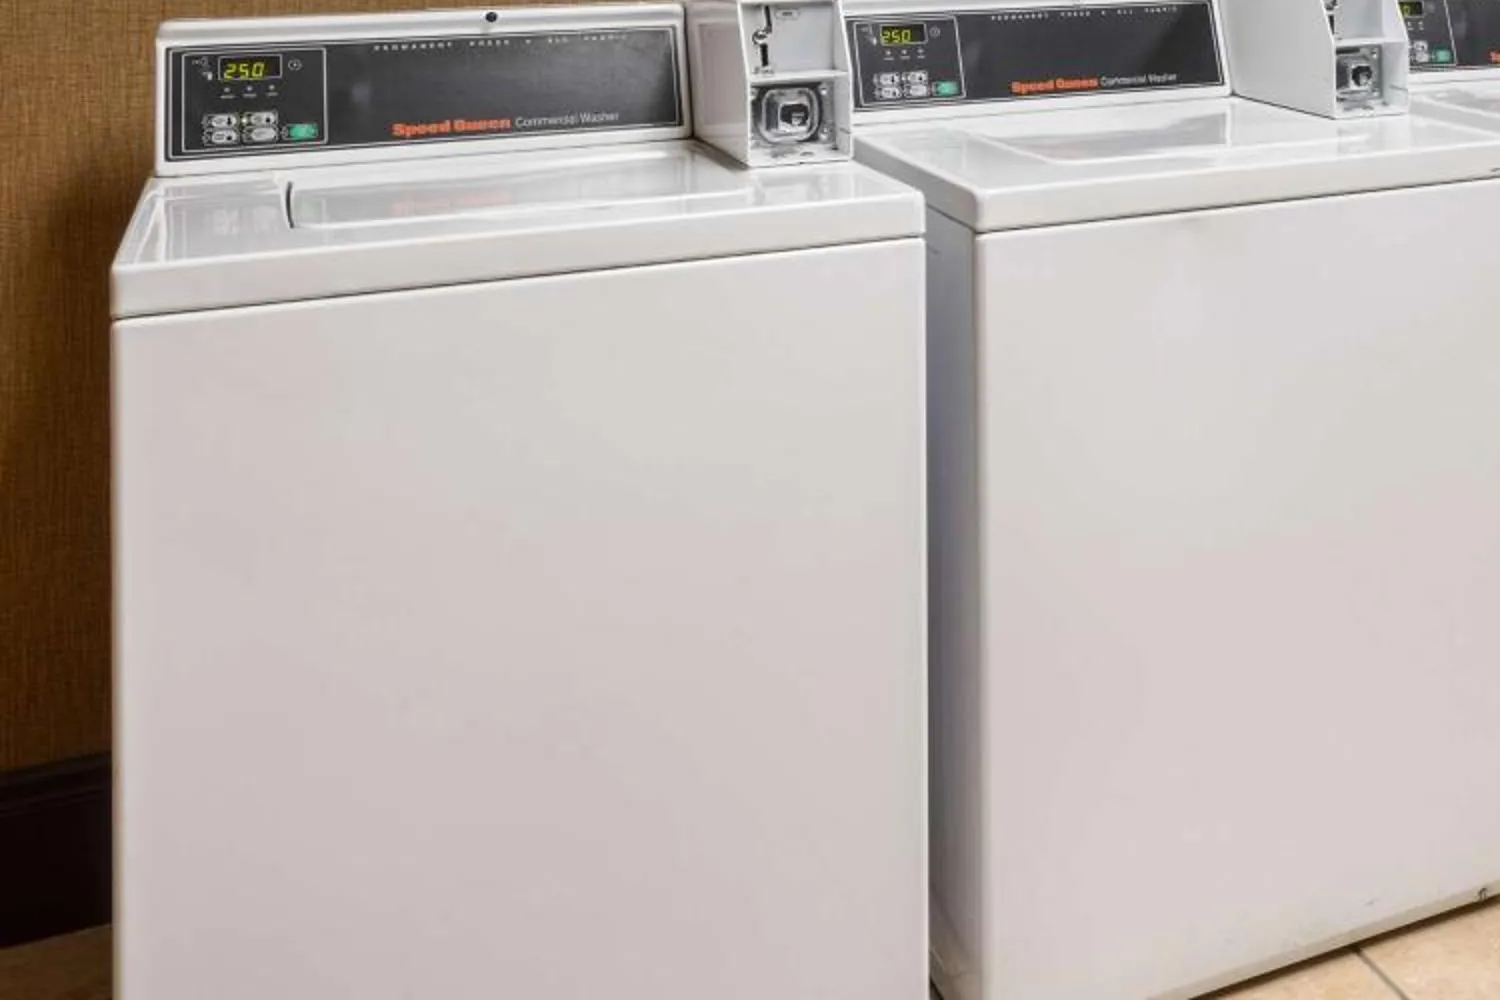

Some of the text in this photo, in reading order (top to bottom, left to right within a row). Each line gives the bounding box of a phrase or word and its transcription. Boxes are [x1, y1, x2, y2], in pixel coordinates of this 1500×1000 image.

[392, 111, 619, 138] Speed Queen Commercial Washer
